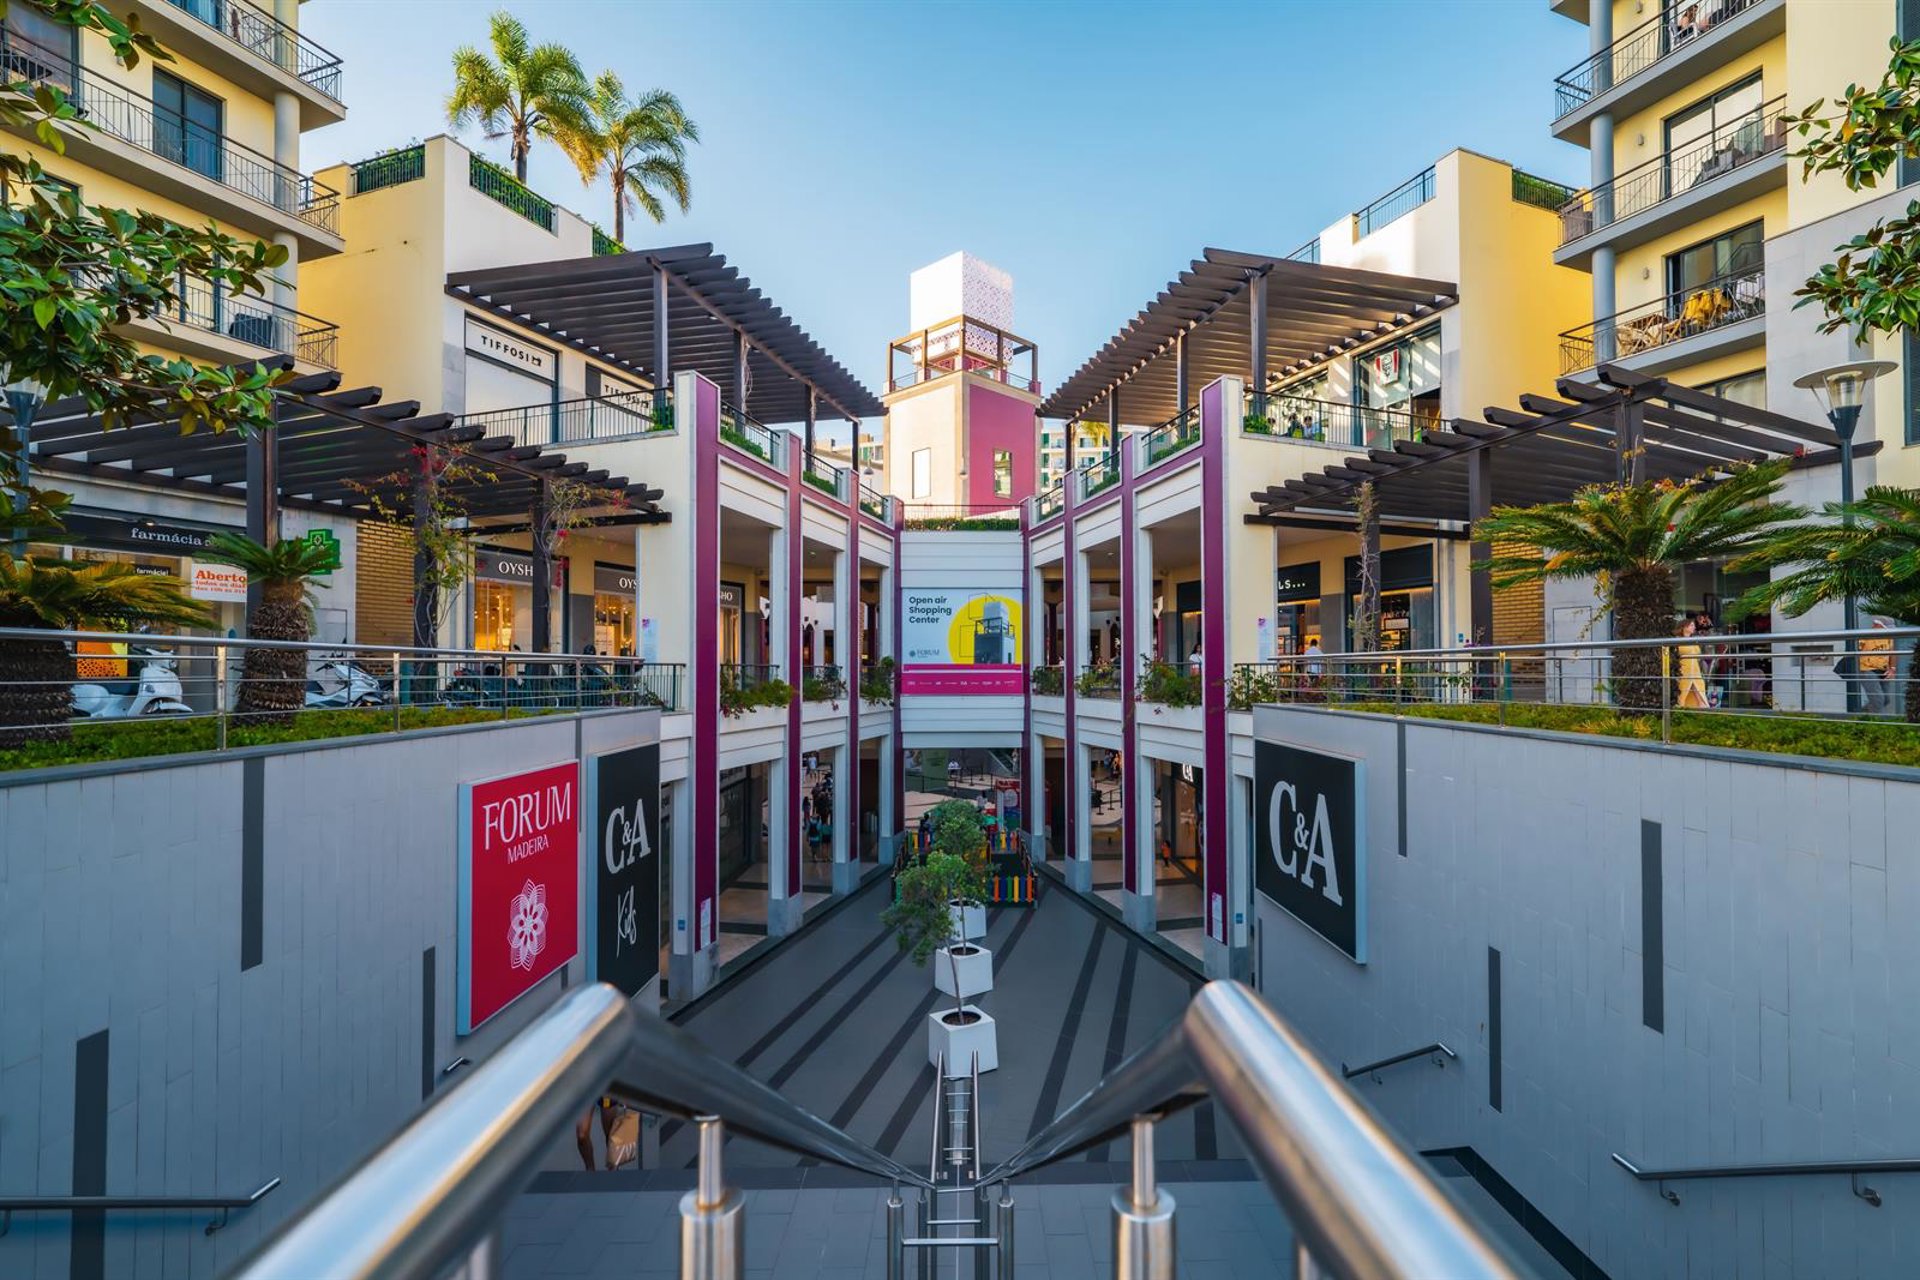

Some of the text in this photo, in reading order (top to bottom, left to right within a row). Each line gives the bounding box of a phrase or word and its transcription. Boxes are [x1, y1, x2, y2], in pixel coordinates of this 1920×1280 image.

[481, 335, 529, 362] TIFFOSI
[131, 528, 203, 546] farmácia
[195, 569, 247, 583] Aberto
[909, 595, 947, 606] Open air
[909, 605, 952, 616] Shopping
[909, 616, 940, 624] Center
[482, 782, 571, 851] FORUM
[507, 834, 549, 864] MADEIRA
[605, 798, 651, 875] C&A
[1269, 780, 1343, 907] C&A
[616, 885, 637, 958] Kids
